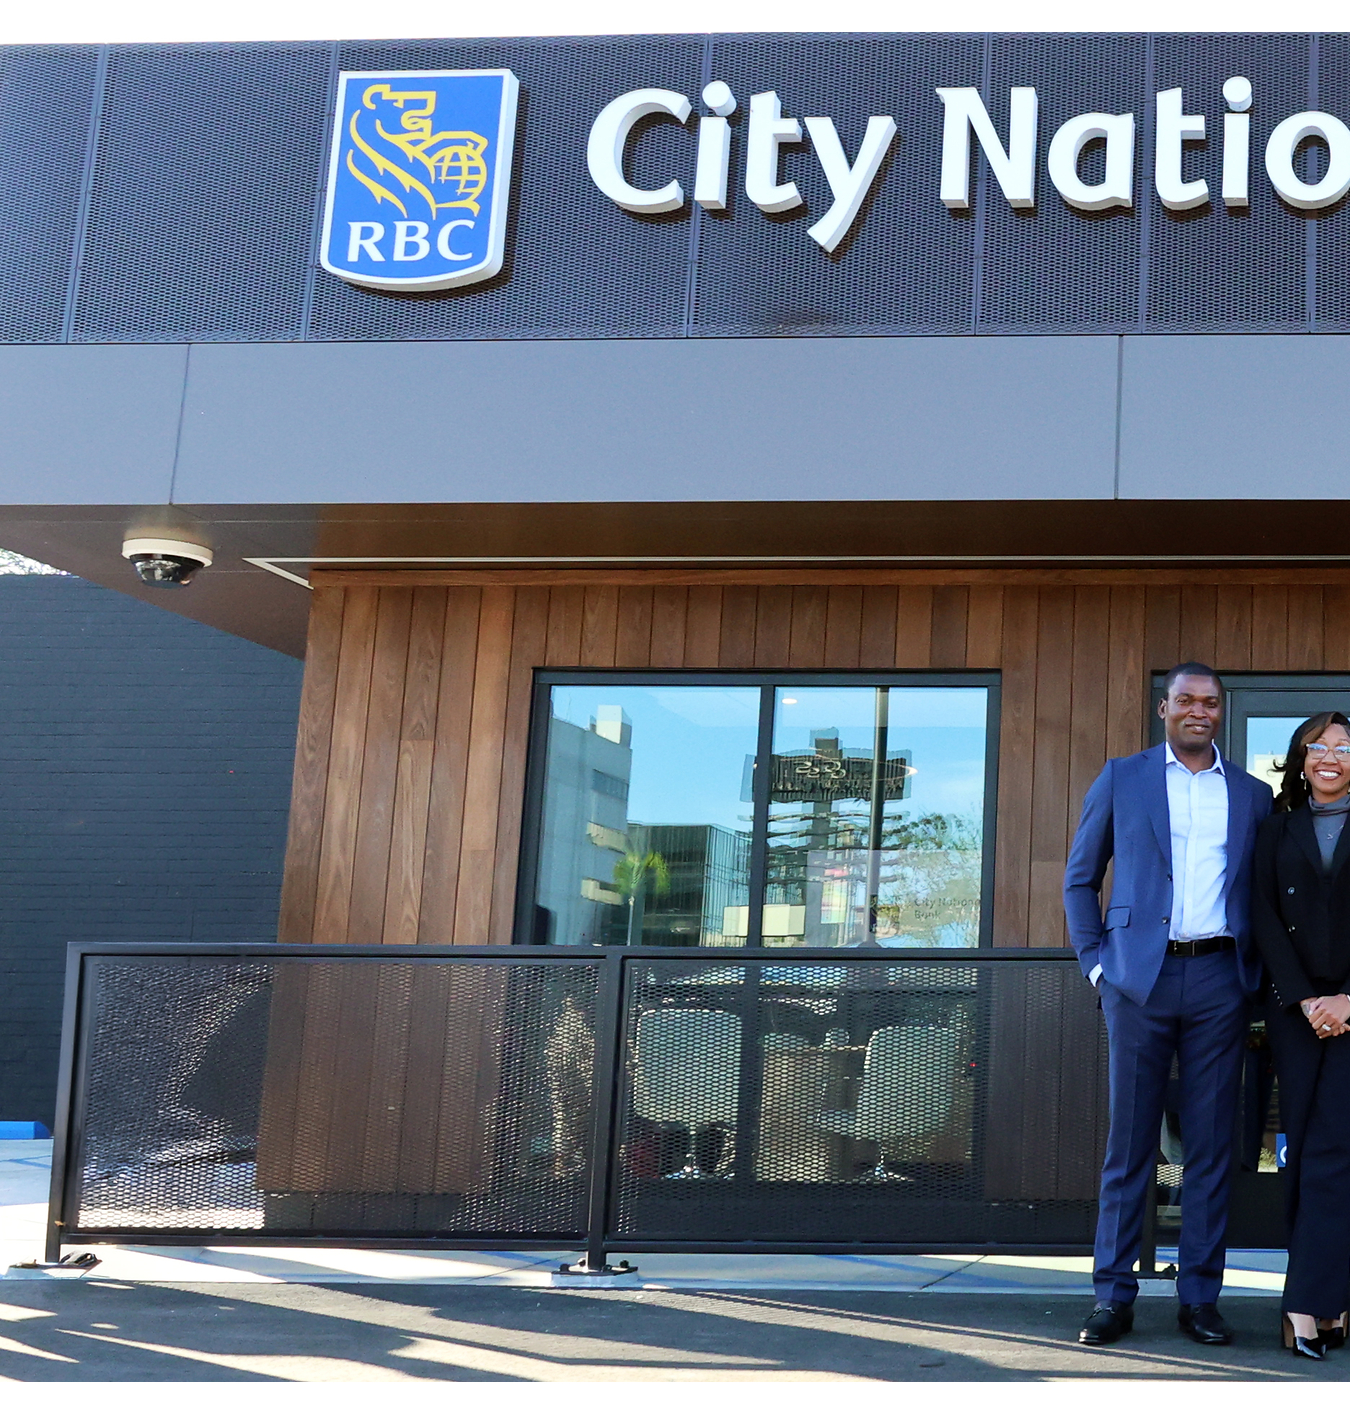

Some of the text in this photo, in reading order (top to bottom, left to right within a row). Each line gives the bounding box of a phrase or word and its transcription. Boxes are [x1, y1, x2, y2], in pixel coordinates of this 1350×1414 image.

[587, 80, 898, 252] City
[347, 219, 475, 262] RBC
[938, 898, 980, 908] Nationa
